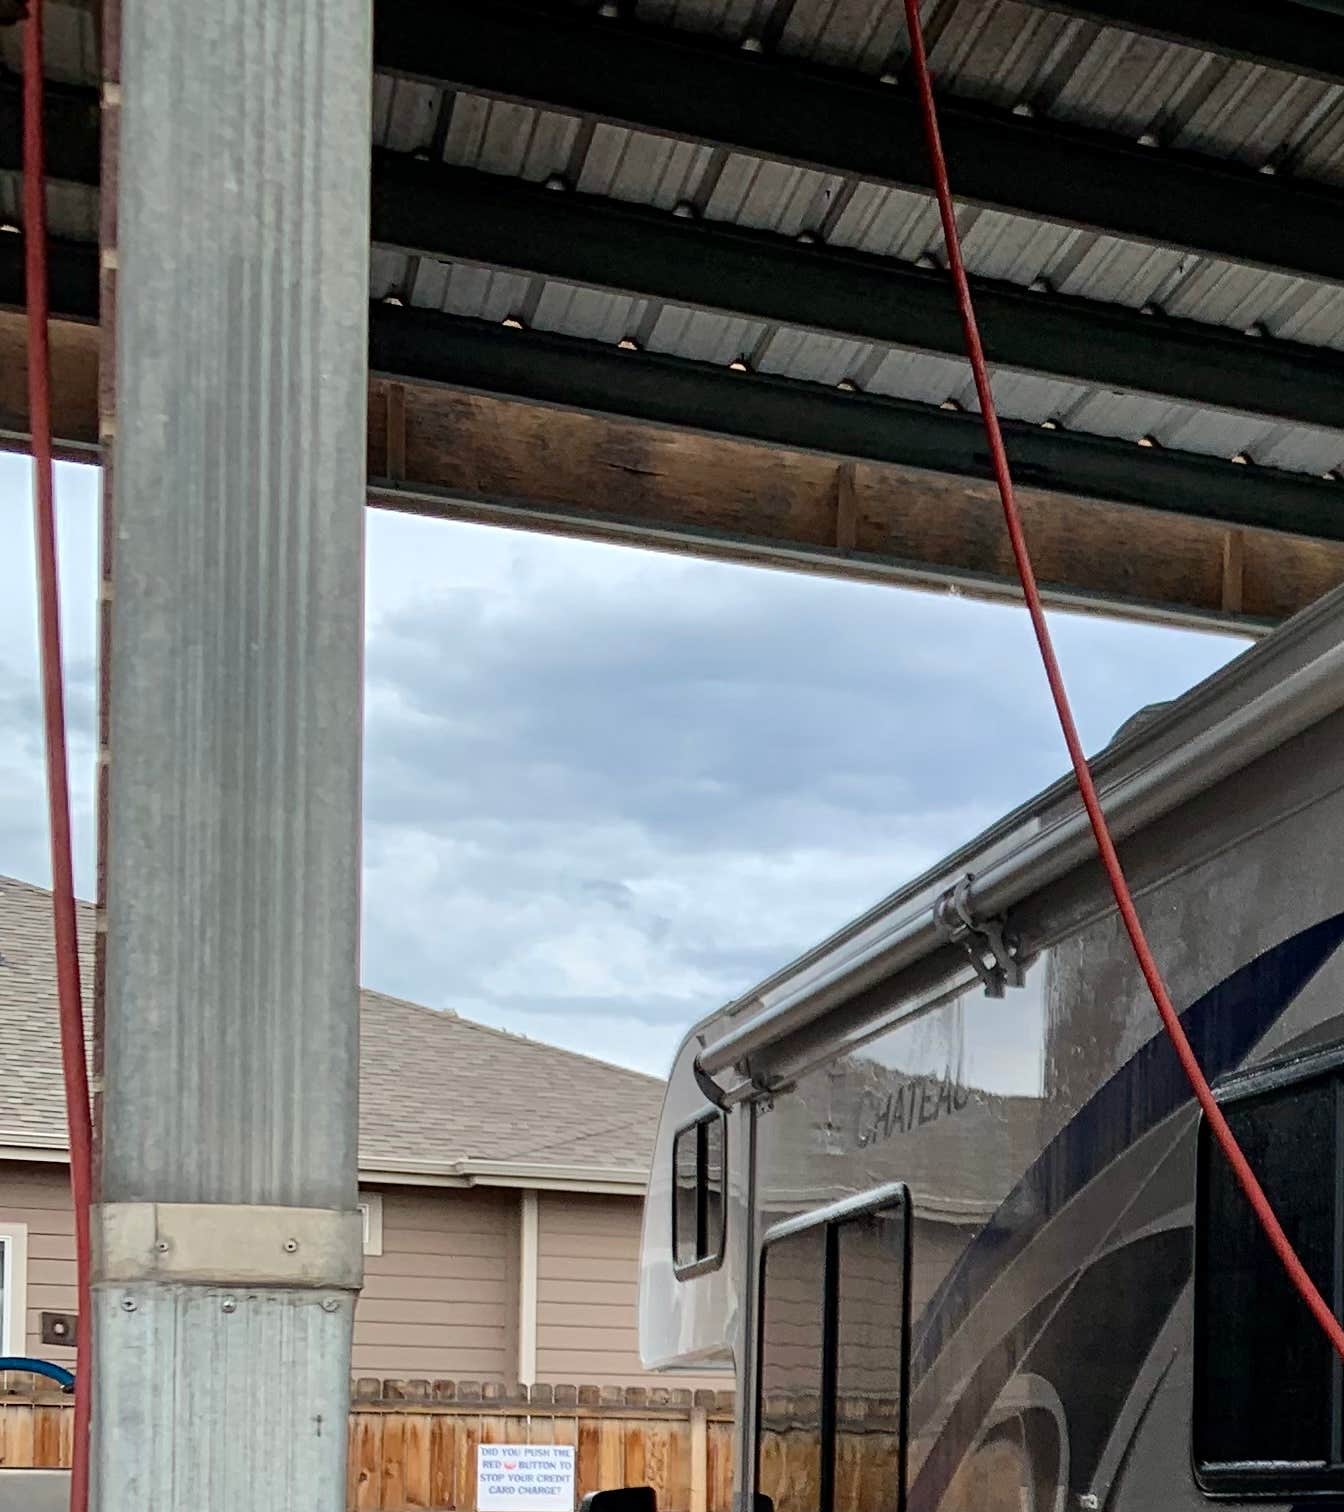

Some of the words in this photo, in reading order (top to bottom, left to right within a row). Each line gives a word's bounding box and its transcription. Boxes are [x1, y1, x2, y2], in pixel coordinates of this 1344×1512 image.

[481, 1447, 499, 1457] DID
[502, 1447, 520, 1457] YOU
[524, 1448, 550, 1457] PUSH
[553, 1448, 570, 1457] THE
[482, 1460, 501, 1469] RED
[518, 1460, 556, 1470] BUTTON
[560, 1461, 572, 1470] TO
[480, 1473, 504, 1482] STOP
[508, 1474, 534, 1483] YOUR
[536, 1474, 571, 1483] CREDIT
[488, 1486, 515, 1495] CARD
[518, 1486, 562, 1496] CHARGE?
